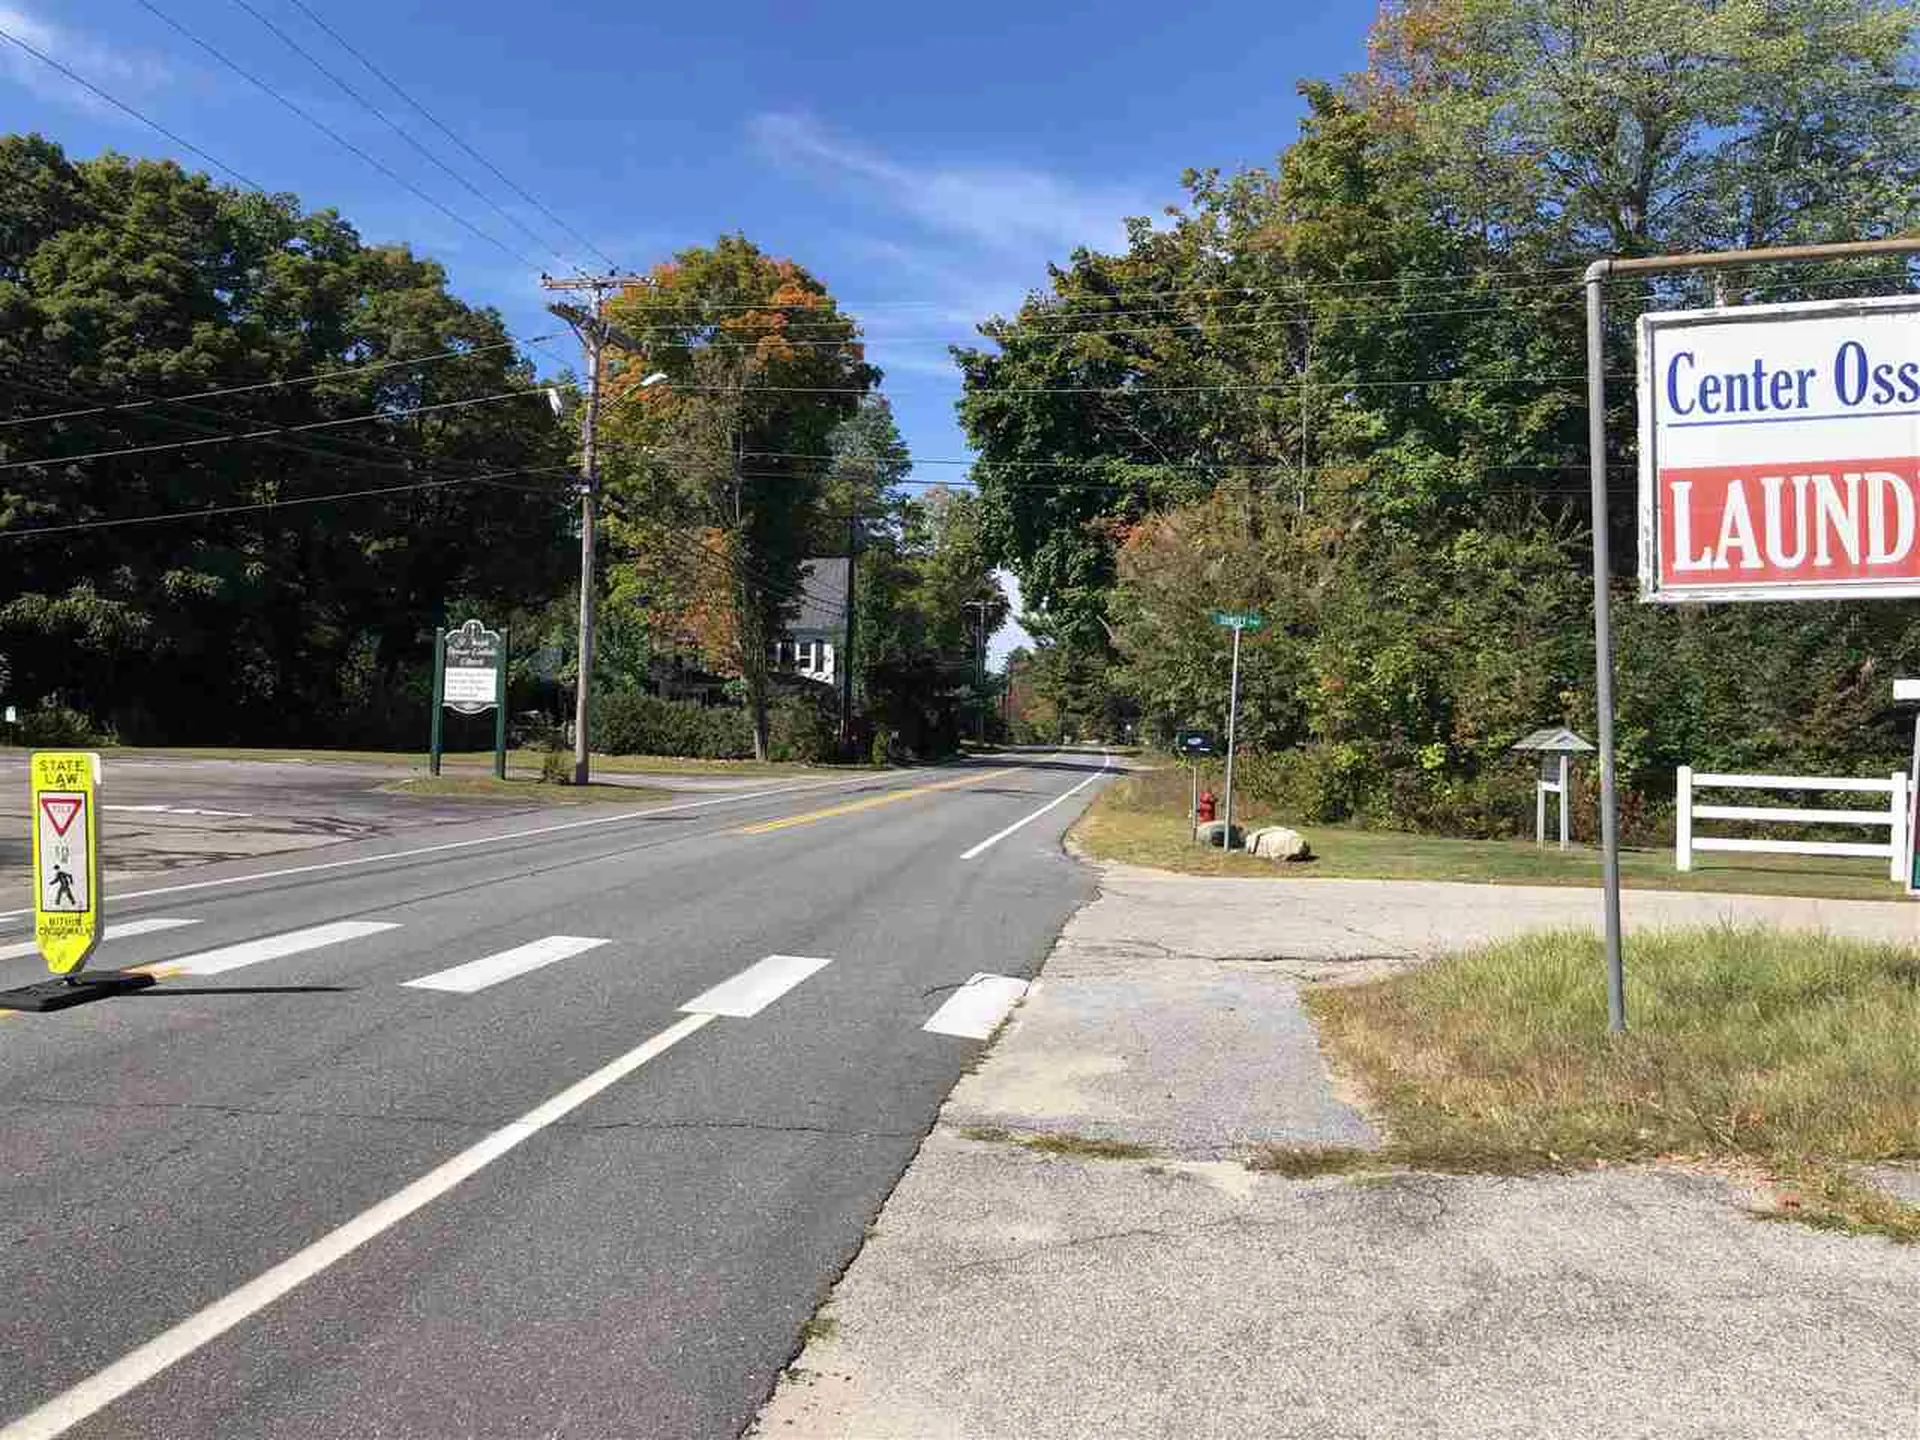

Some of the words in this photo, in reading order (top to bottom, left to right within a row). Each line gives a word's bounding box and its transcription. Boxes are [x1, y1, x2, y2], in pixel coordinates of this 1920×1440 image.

[1667, 350, 1816, 416] Center
[1834, 340, 1920, 407] Oss
[1670, 471, 1920, 571] LAUND
[38, 759, 85, 772] STATE
[45, 773, 78, 784] LAW
